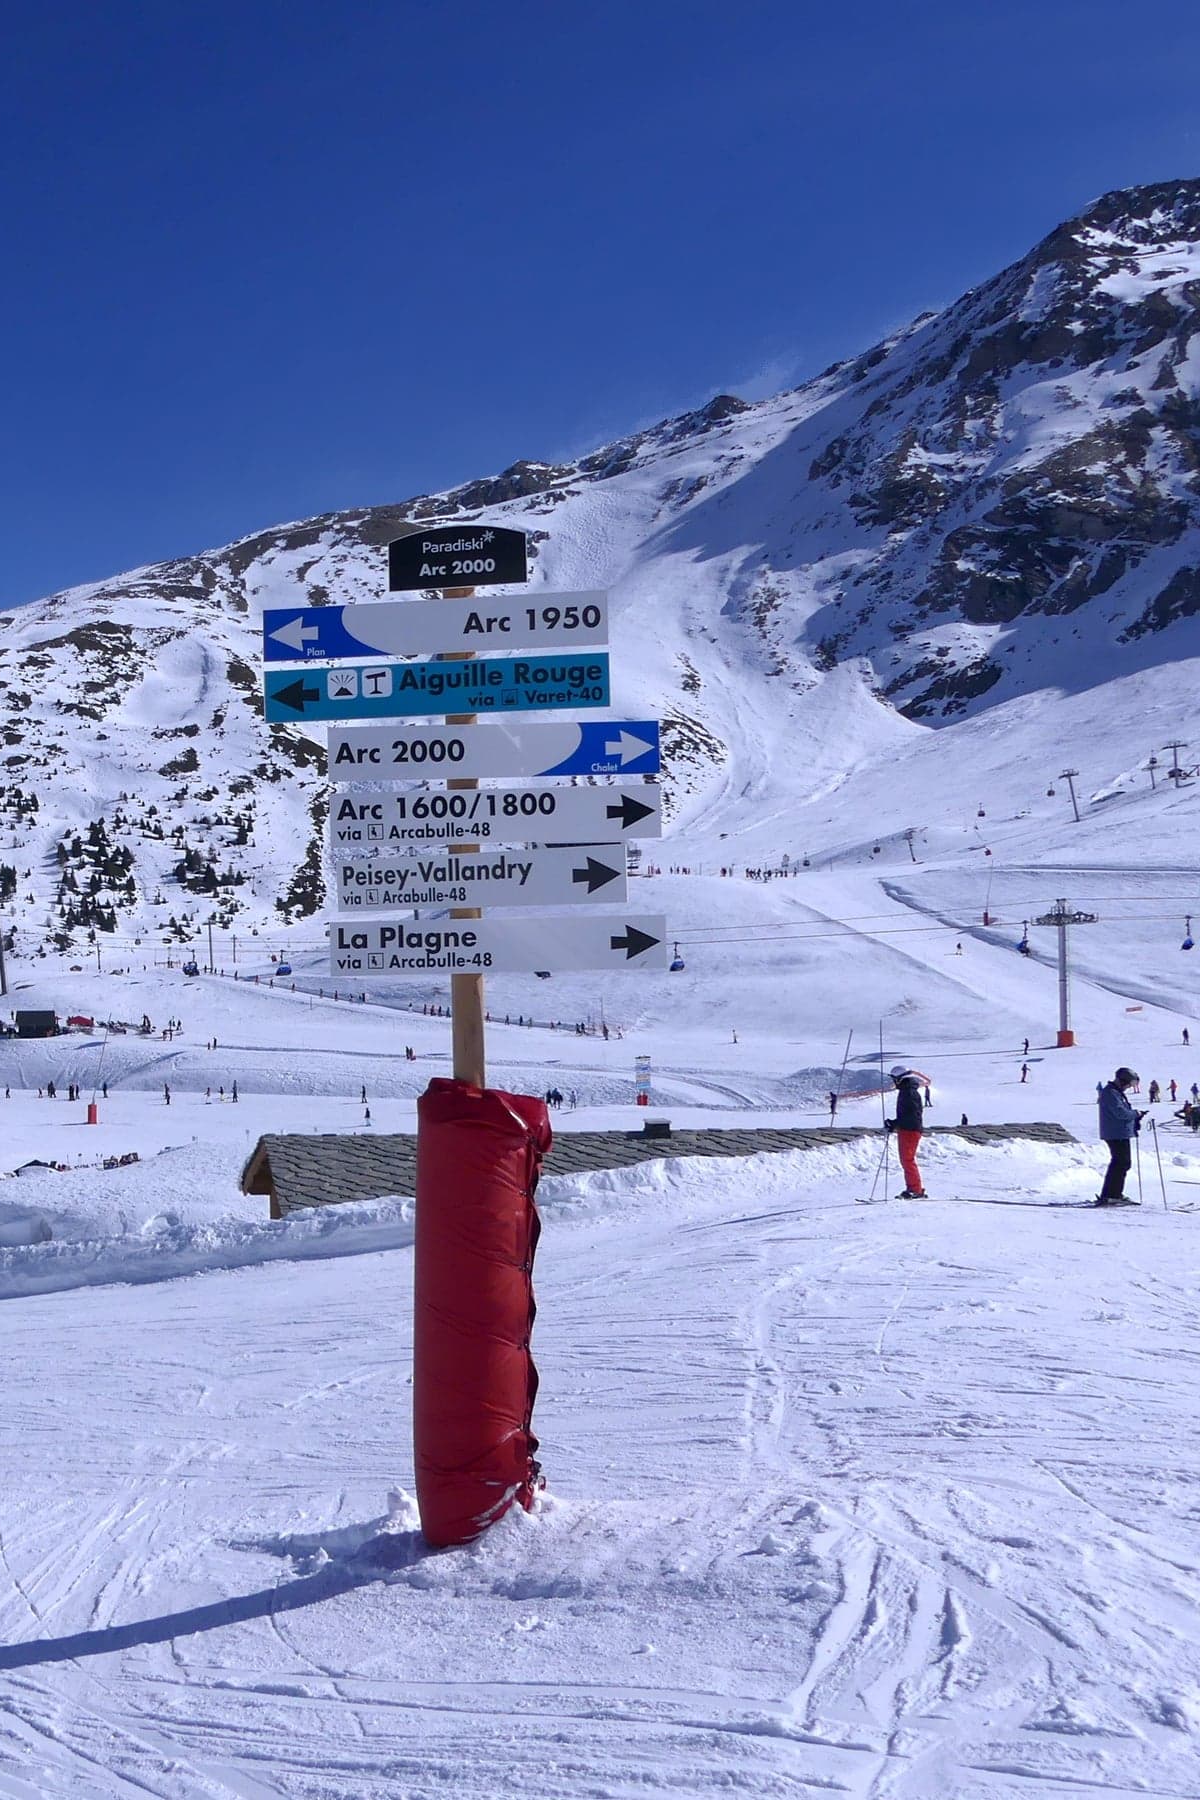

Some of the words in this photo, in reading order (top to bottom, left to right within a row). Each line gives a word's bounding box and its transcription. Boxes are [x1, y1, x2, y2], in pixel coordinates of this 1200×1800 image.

[422, 537, 484, 554] Paradiski
[419, 560, 446, 577] Arc
[452, 558, 495, 575] 2000
[463, 611, 511, 635] Arc
[525, 604, 601, 631] 1950
[306, 646, 325, 657] Plan
[400, 663, 503, 695] Aiguille
[513, 662, 602, 690] Rouge
[468, 693, 494, 707] via
[525, 686, 603, 704] Varet-40
[335, 742, 381, 764] Arc
[392, 739, 465, 763] 2000
[591, 763, 618, 773] Chalet
[337, 799, 383, 821] Arc
[396, 792, 556, 820] 1600/1800
[337, 826, 362, 841] via
[388, 822, 491, 840] Arcabulle-48
[342, 856, 533, 890] Peisey-Vallandry
[343, 892, 362, 905] via
[382, 887, 466, 904] Arcabulle-48
[337, 928, 368, 949] La
[380, 926, 477, 954] Plagne
[337, 956, 362, 970] via
[389, 952, 493, 969] Arcabulle-48
